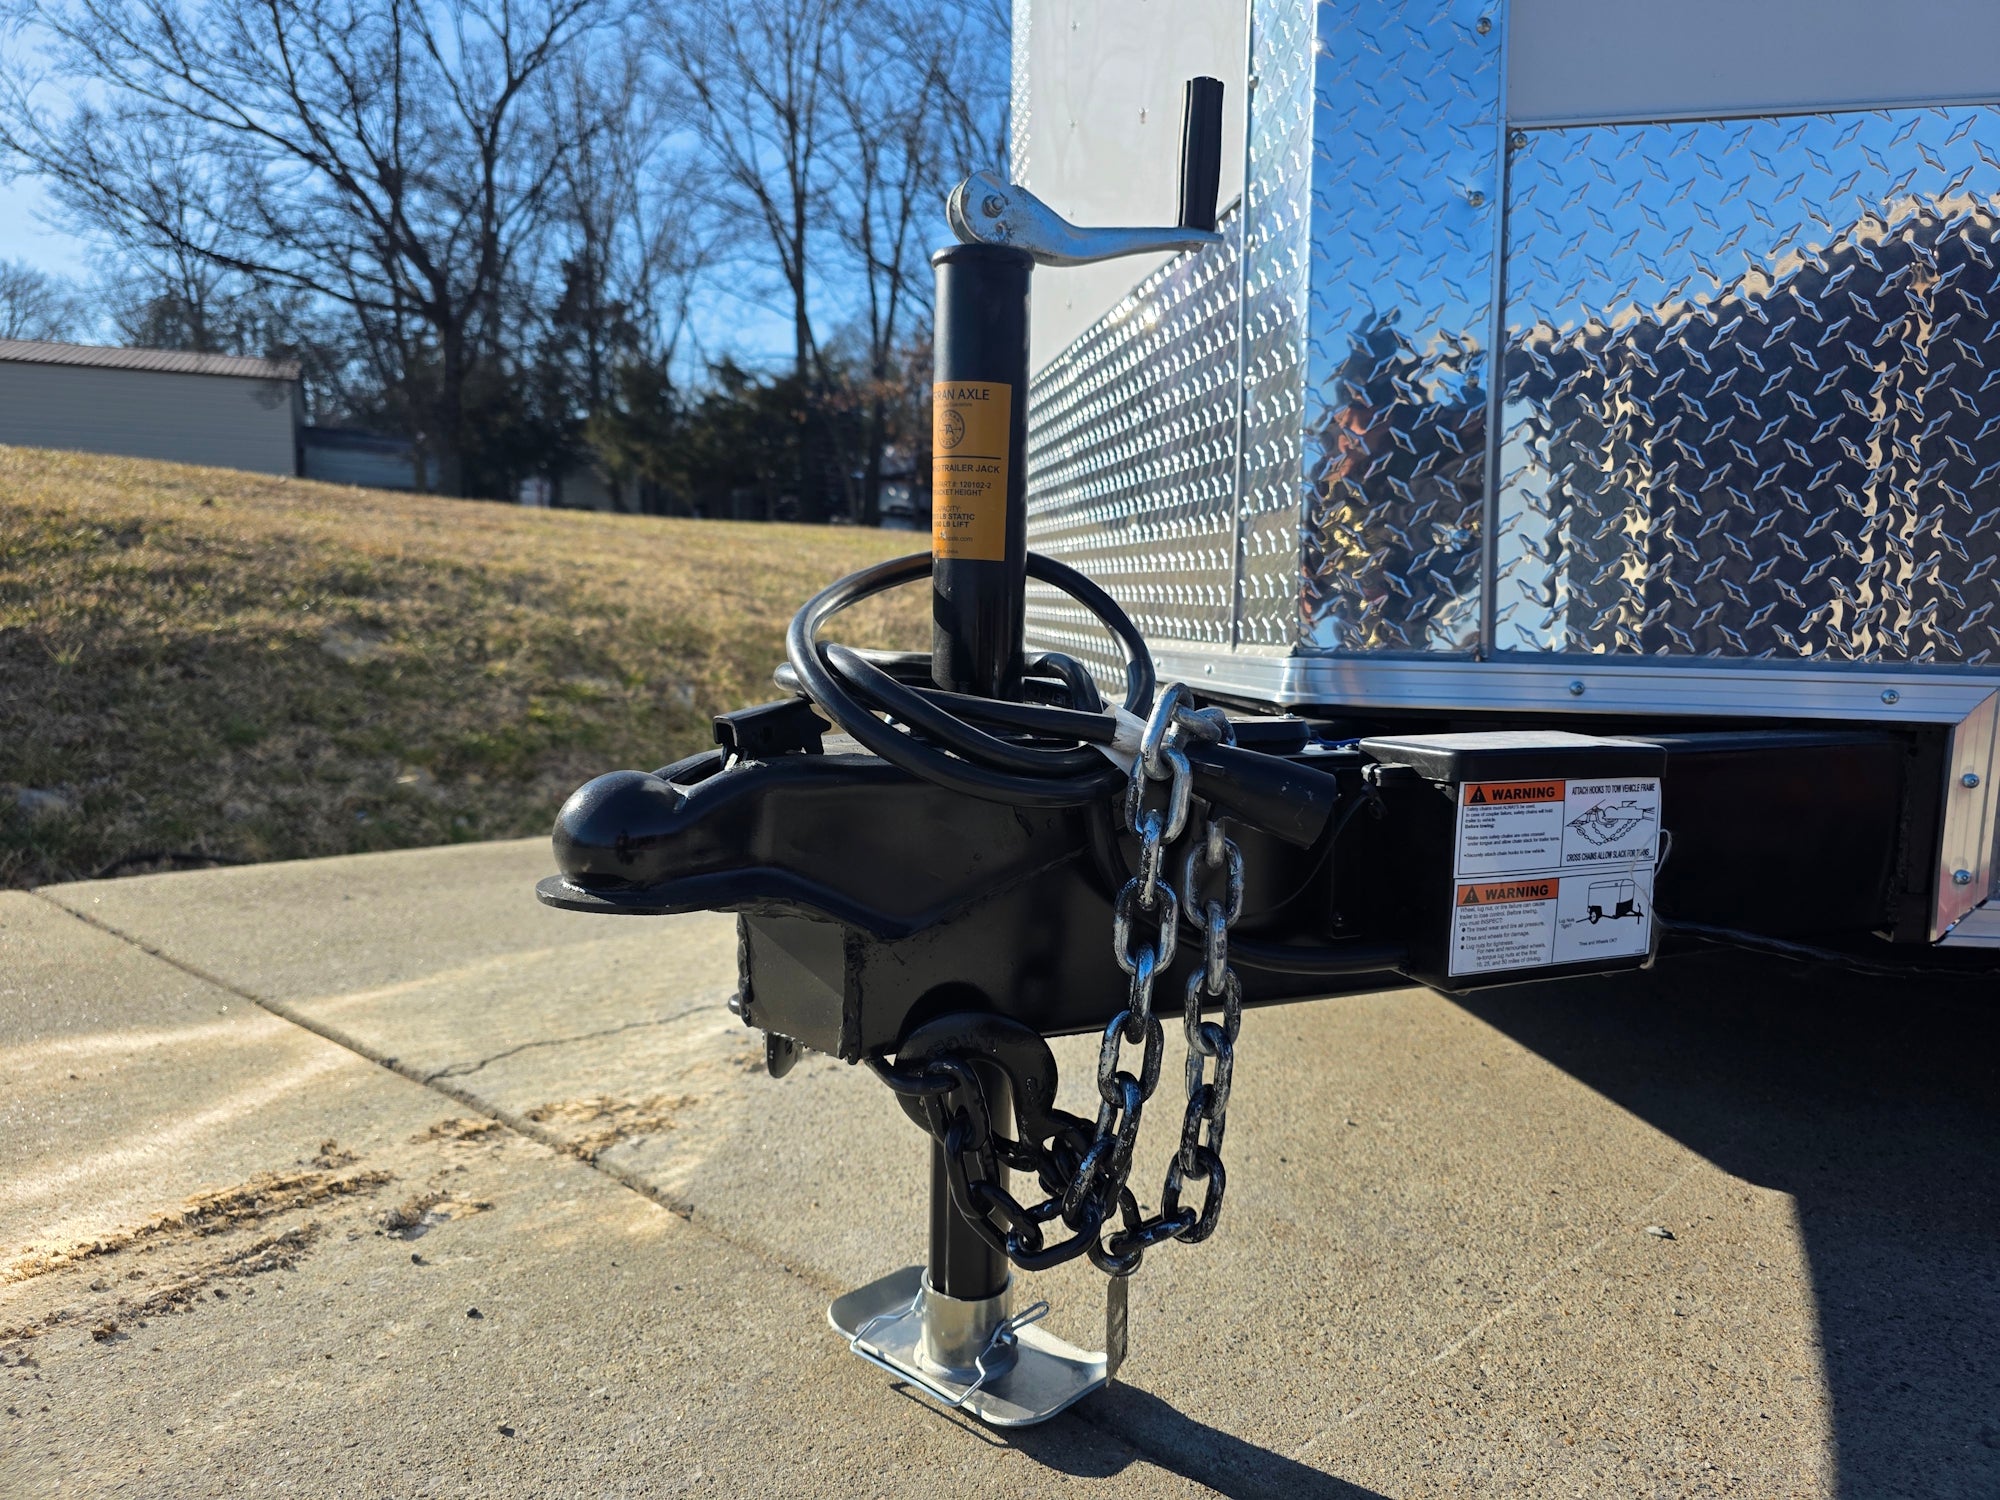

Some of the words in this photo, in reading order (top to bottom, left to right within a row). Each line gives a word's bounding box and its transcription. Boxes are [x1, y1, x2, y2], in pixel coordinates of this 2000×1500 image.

[958, 388, 990, 401] AXLE
[942, 464, 974, 472] TRAILER
[976, 465, 1000, 474] JACK
[948, 512, 976, 521] STATIC
[1492, 786, 1555, 800] WARNING
[1572, 786, 1588, 796] ATTACH
[1589, 785, 1604, 795] HOOKS
[1605, 784, 1612, 794] TO
[1612, 784, 1621, 794] TOW
[1622, 784, 1640, 793] VEHICLE
[1640, 782, 1656, 792] FRAME
[1486, 884, 1549, 900] WARNING
